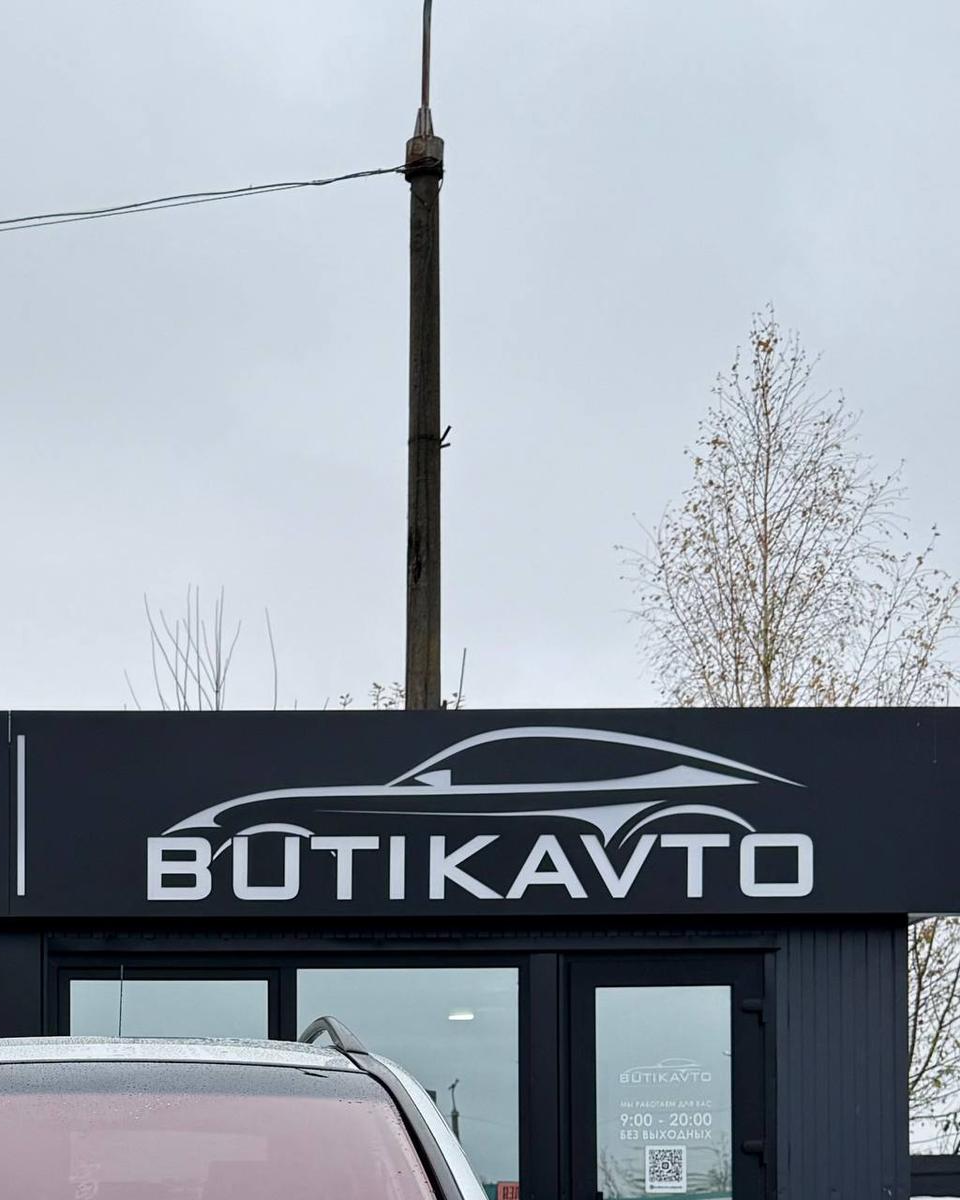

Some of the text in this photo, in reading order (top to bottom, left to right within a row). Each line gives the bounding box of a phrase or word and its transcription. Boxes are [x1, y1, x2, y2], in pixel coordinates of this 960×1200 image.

[146, 832, 815, 901] BUTIKAVTO
[619, 1072, 712, 1083] BUTIKAVTO
[620, 1113, 653, 1127] 9:00
[669, 1112, 713, 1127] 20:00
[620, 1129, 713, 1141] БЕЗ ВЫХОДНЫХ
